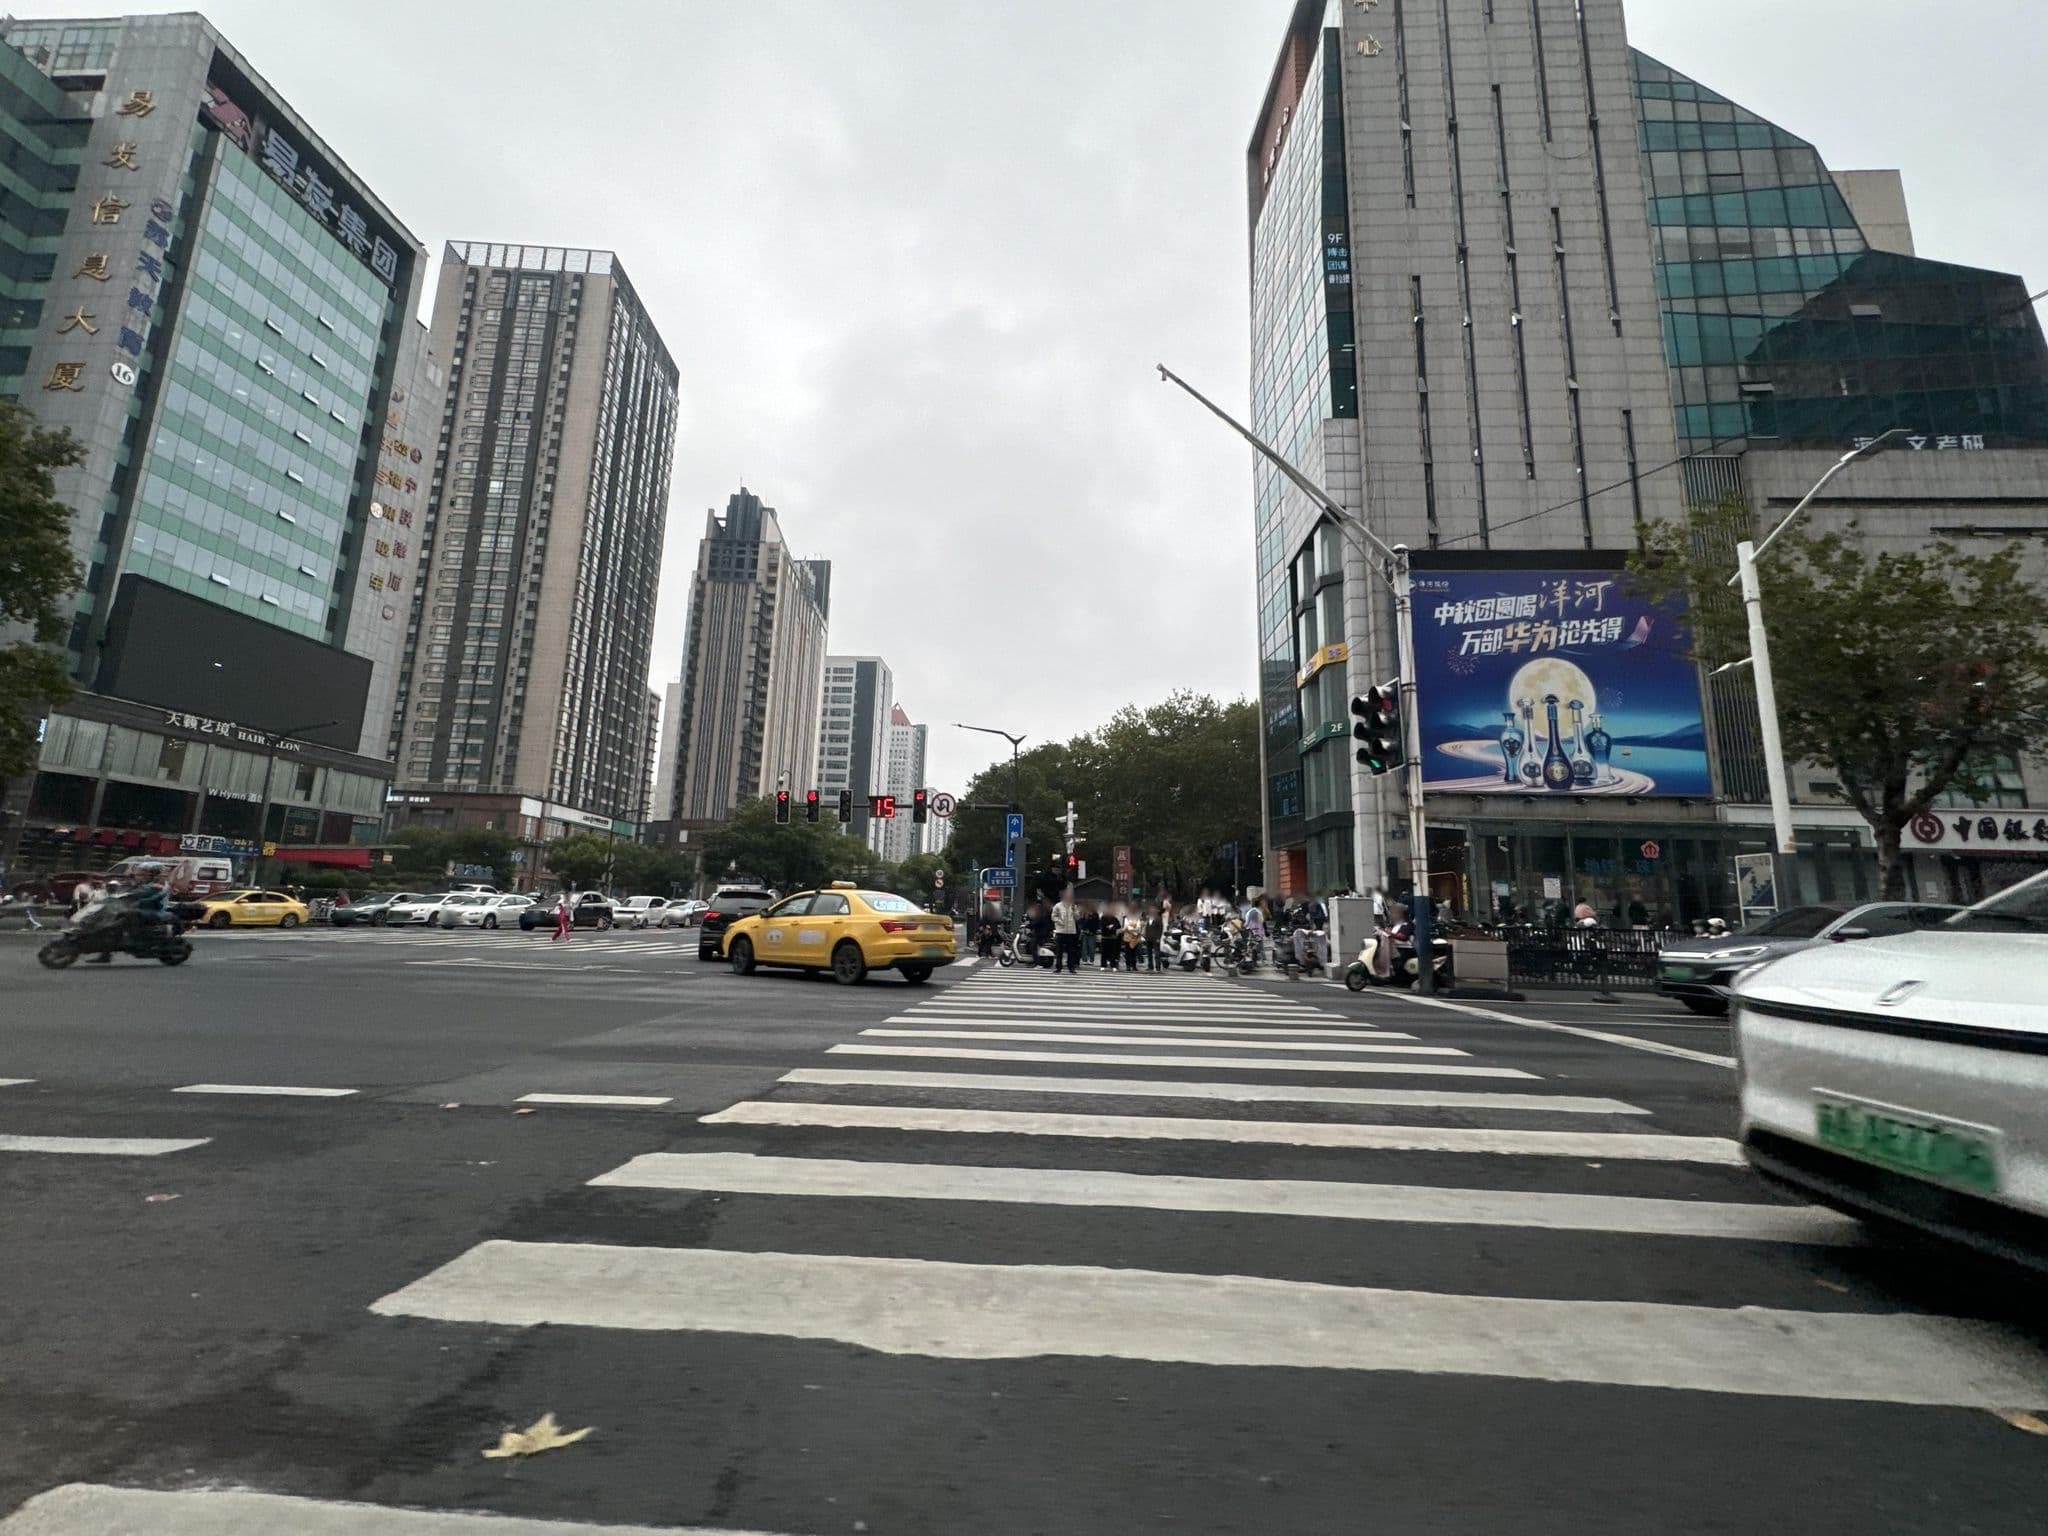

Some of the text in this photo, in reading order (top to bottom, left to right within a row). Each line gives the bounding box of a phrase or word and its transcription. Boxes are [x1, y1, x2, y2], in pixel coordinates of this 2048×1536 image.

[262, 128, 398, 283] 易发集团
[42, 89, 156, 393] 易发信息大厦
[1327, 233, 1343, 244] 9F
[114, 364, 133, 383] 16
[1459, 616, 1625, 656] 万部华为抢先得
[237, 730, 266, 746] HAIR
[1330, 723, 1344, 734] 2F
[208, 787, 218, 797] W
[219, 789, 246, 801] Hymn
[875, 798, 895, 818] 15
